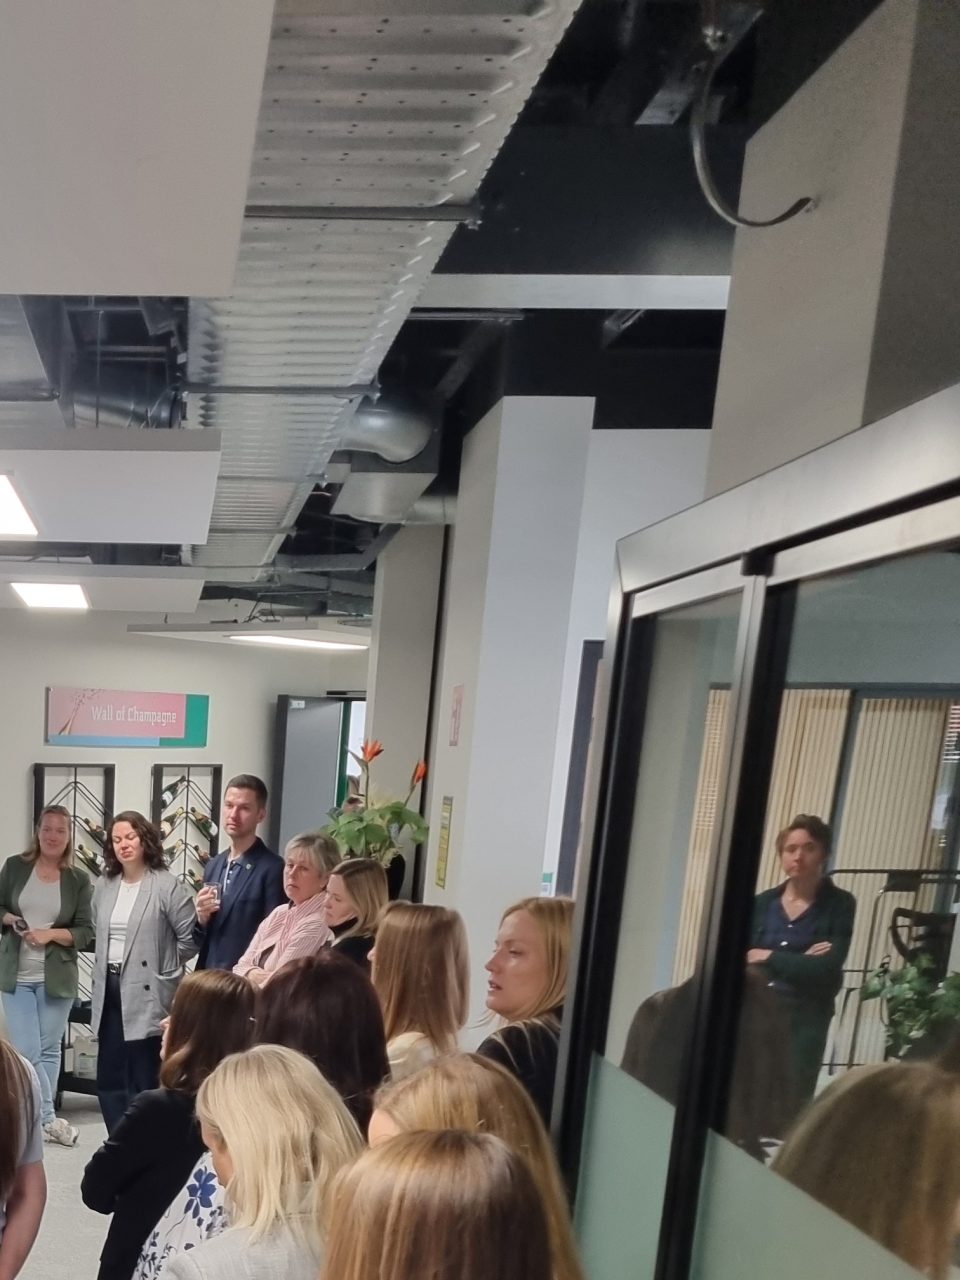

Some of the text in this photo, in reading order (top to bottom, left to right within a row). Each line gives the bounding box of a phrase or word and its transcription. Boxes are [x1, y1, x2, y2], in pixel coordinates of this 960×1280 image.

[91, 704, 177, 726] Wall of Champagne
